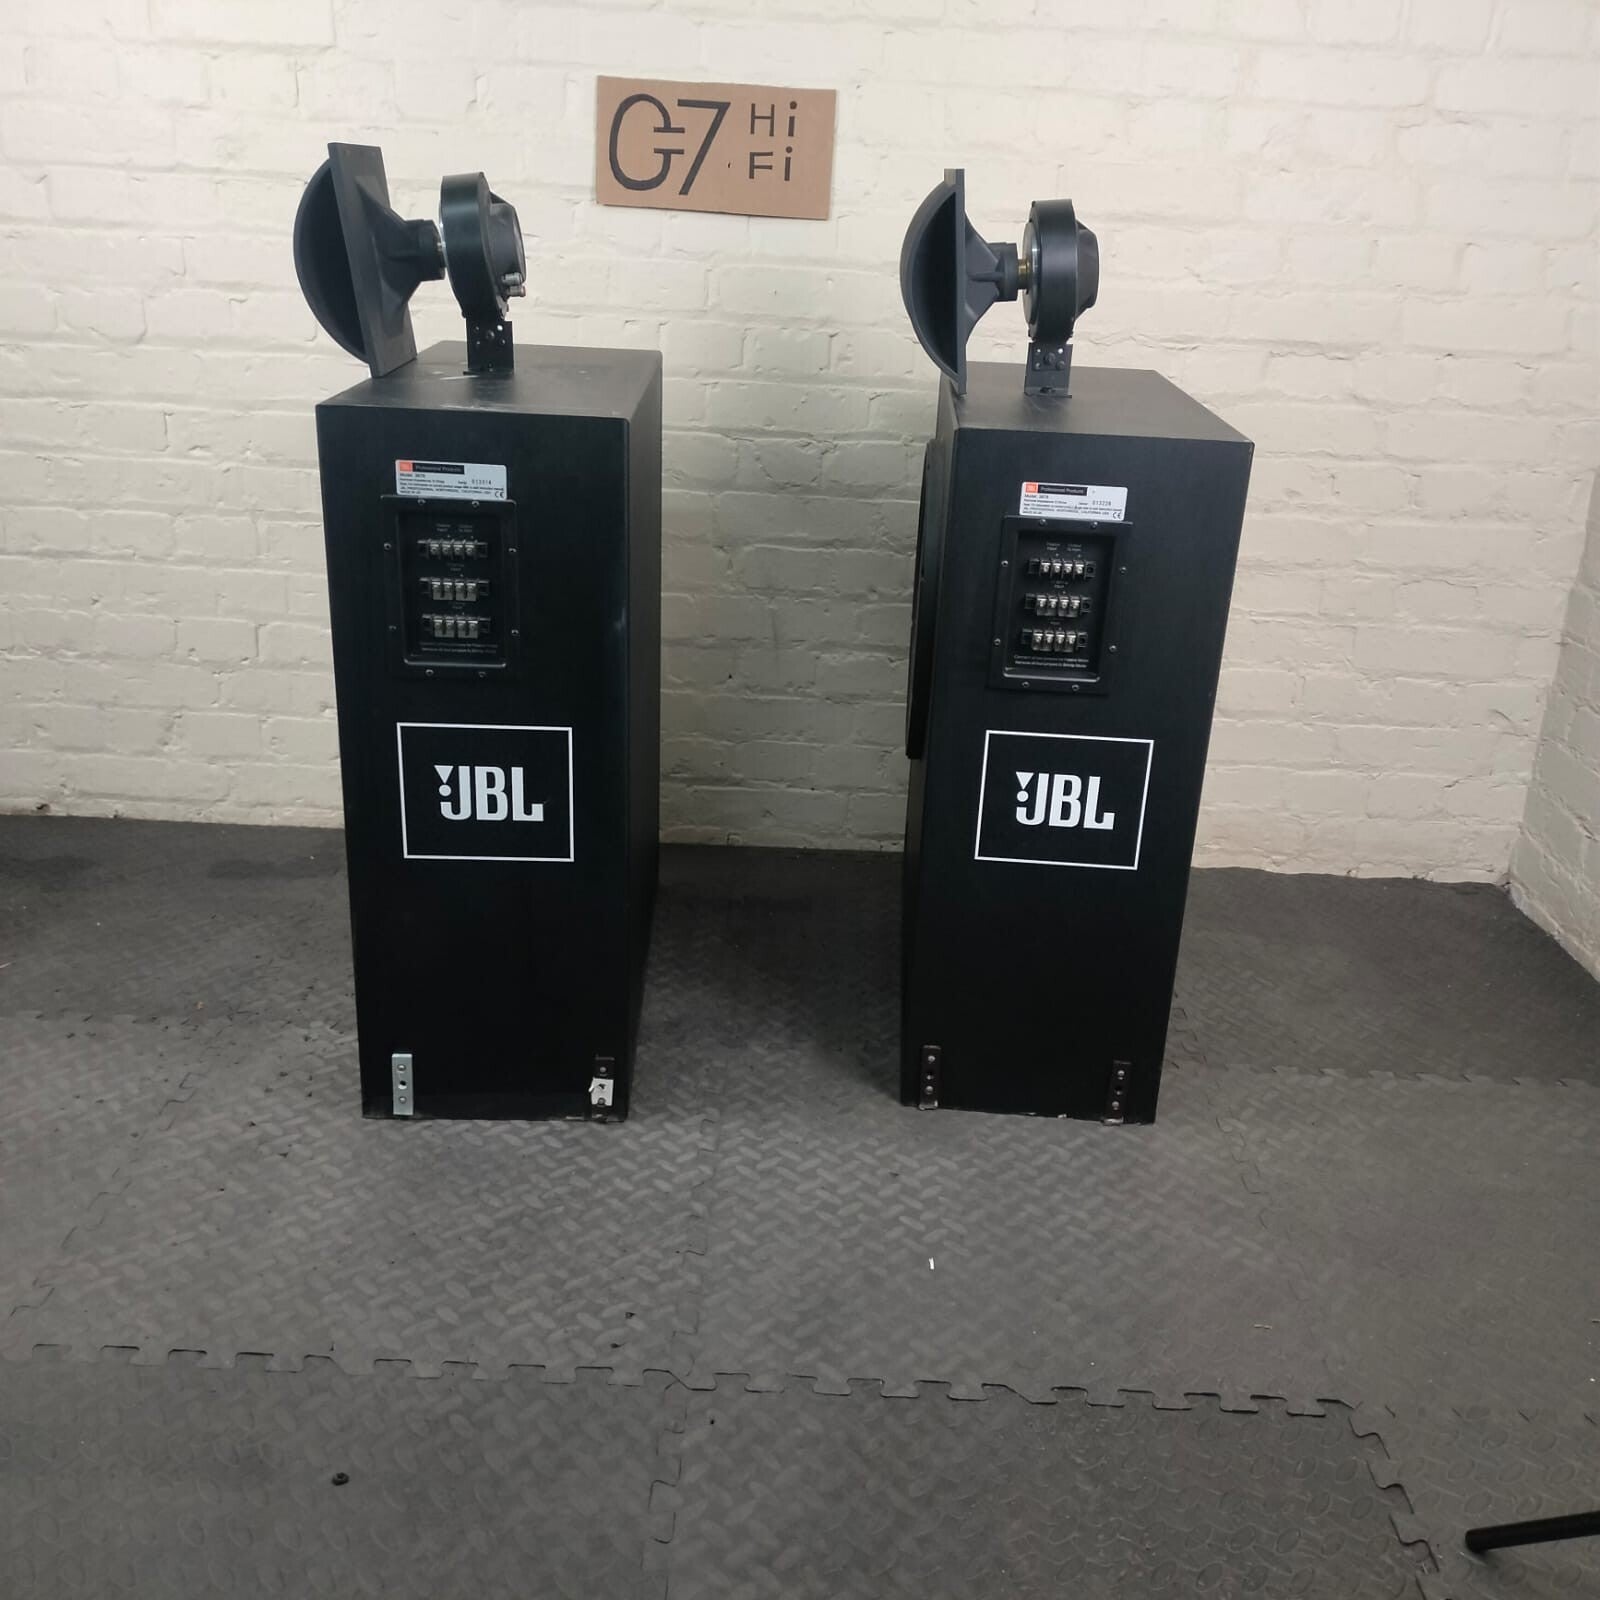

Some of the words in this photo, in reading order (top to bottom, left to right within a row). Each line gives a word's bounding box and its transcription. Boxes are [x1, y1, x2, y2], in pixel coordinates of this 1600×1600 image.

[609, 93, 731, 195] G7
[750, 101, 797, 137] Hi
[749, 146, 793, 182] Fi
[434, 765, 544, 822] JBL
[1015, 771, 1115, 830] JBL
